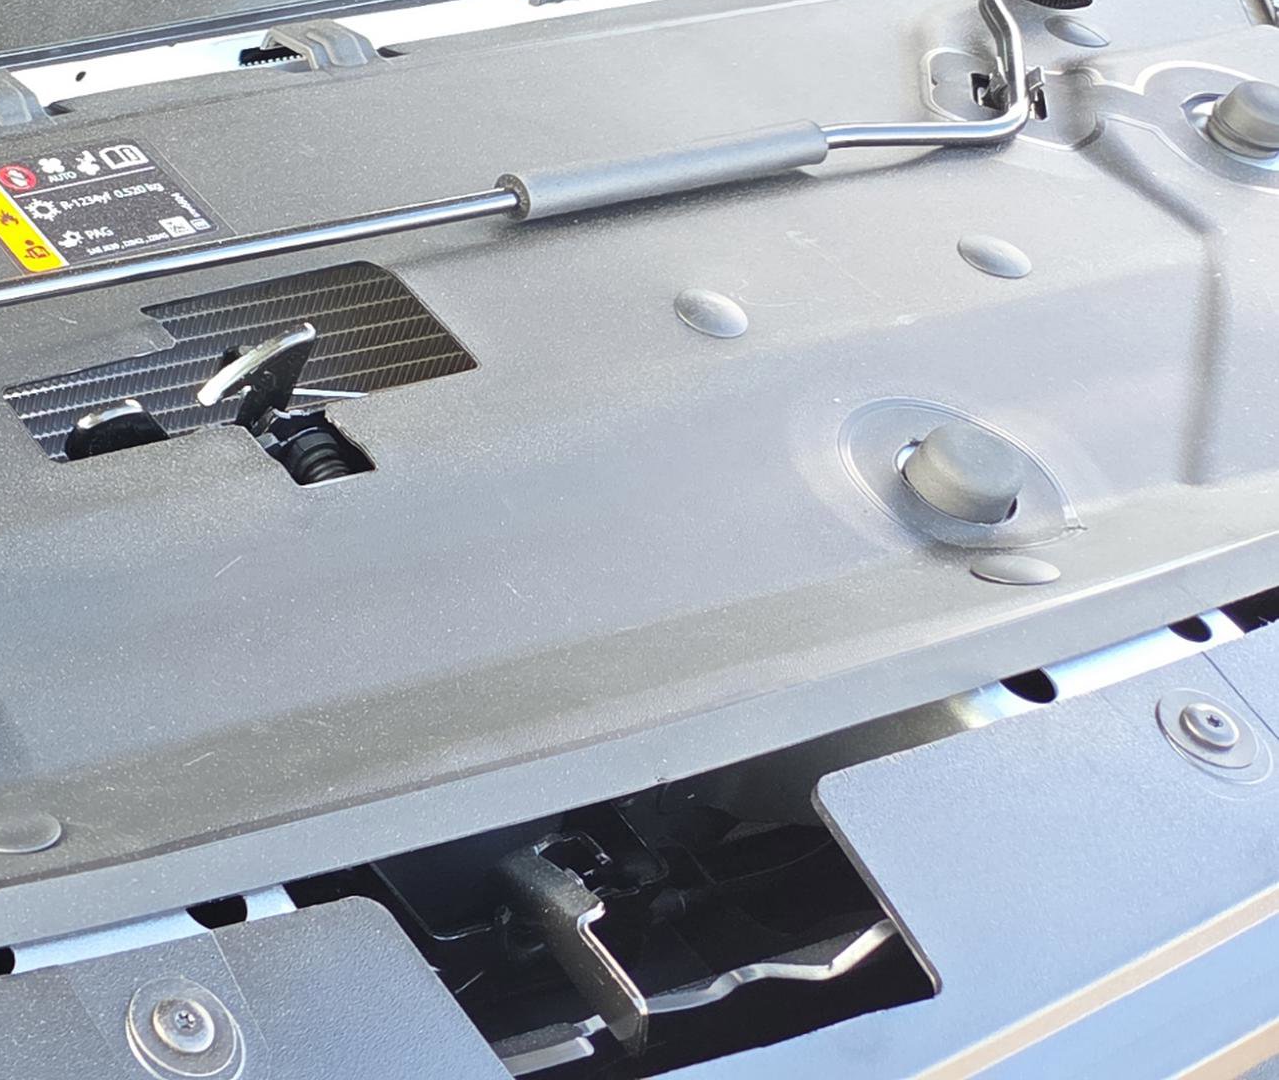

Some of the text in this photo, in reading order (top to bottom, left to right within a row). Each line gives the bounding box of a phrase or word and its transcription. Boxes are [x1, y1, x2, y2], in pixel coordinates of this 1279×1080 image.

[48, 171, 77, 183] AUTO
[59, 182, 165, 209] R-1234yf 0.520 kg
[84, 226, 115, 240] PAG
